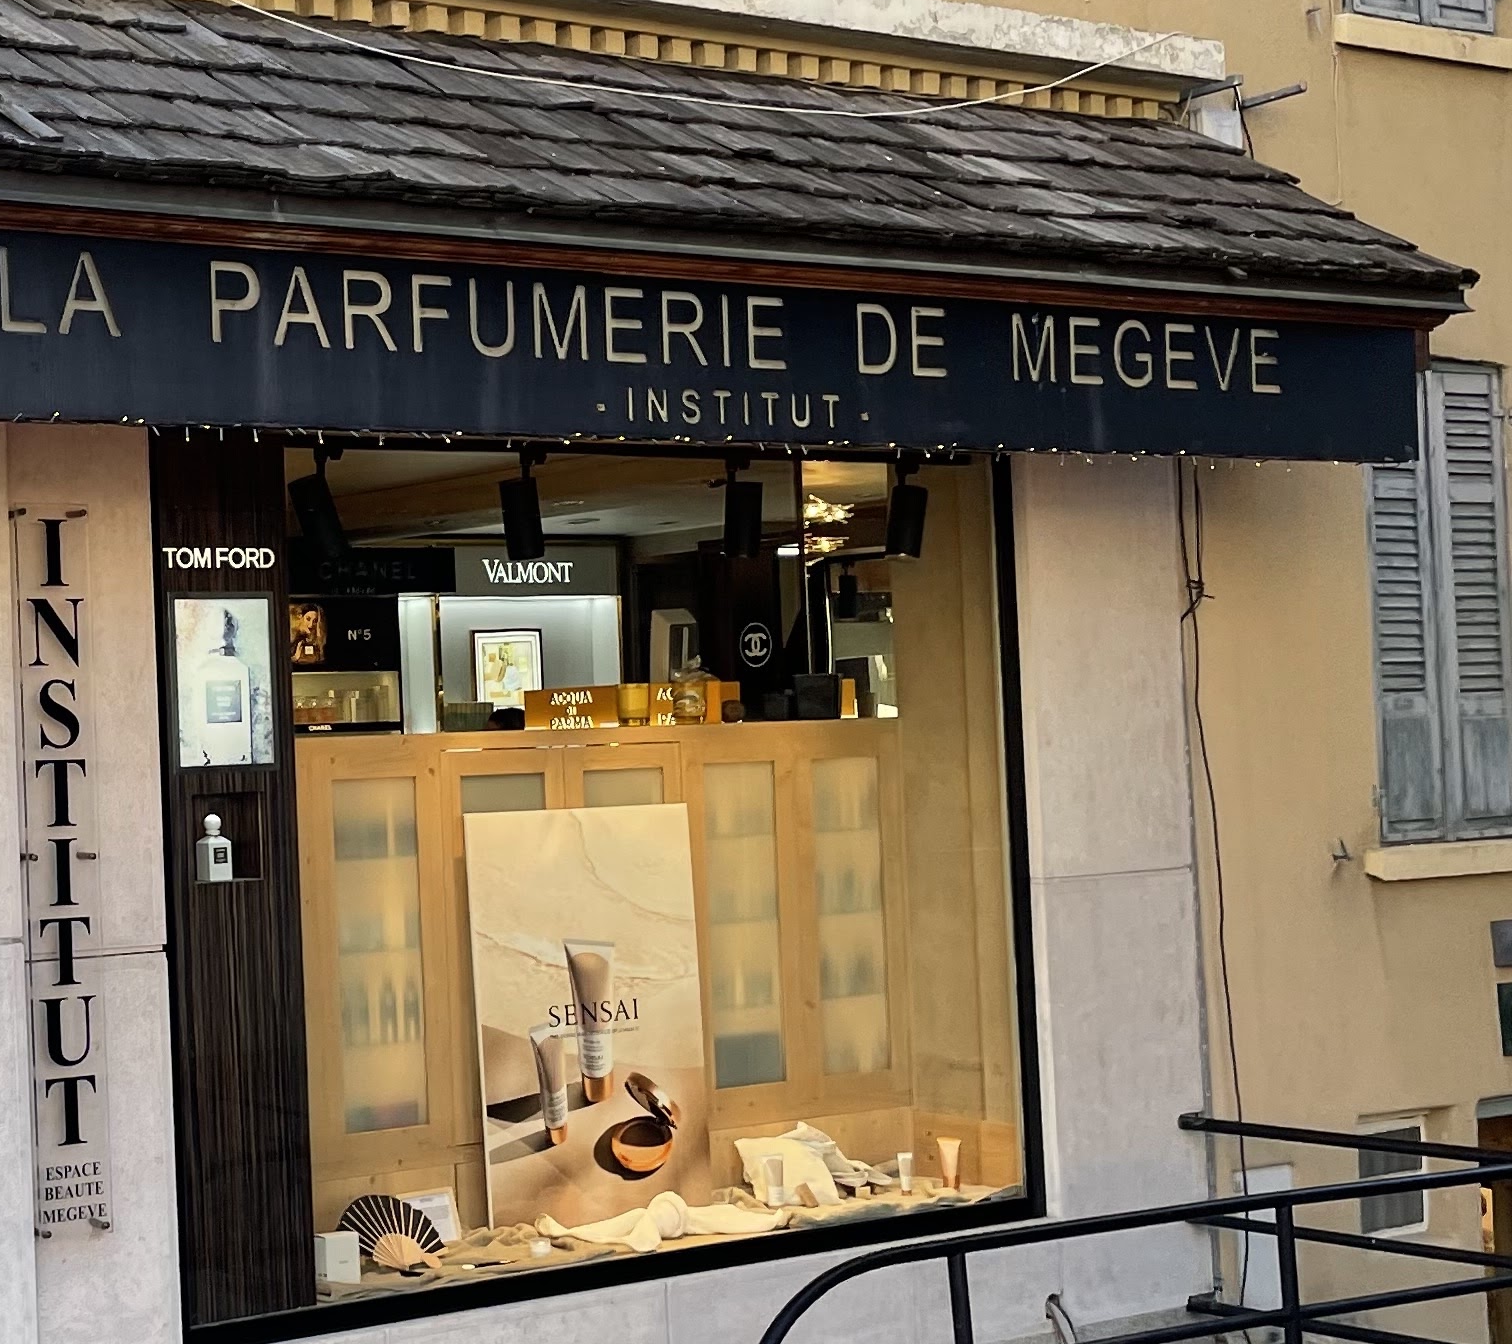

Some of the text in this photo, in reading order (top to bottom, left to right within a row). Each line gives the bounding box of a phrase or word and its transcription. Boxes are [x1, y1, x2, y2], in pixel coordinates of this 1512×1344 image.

[209, 259, 787, 371] PARFUMERIE
[856, 302, 948, 378] DE
[1010, 312, 1282, 395] MEGEVE
[627, 387, 841, 429] INSTITUT
[162, 546, 276, 569] TOM FORD
[482, 558, 574, 584] VALMONT
[550, 690, 593, 706] ACQUA
[551, 716, 594, 730] PARMA
[25, 518, 98, 1148] INSTITUT
[548, 997, 639, 1028] SENSAI
[45, 1161, 102, 1181] ESPACE
[44, 1180, 105, 1202] BEAUTE
[42, 1202, 108, 1225] MEGEVE
